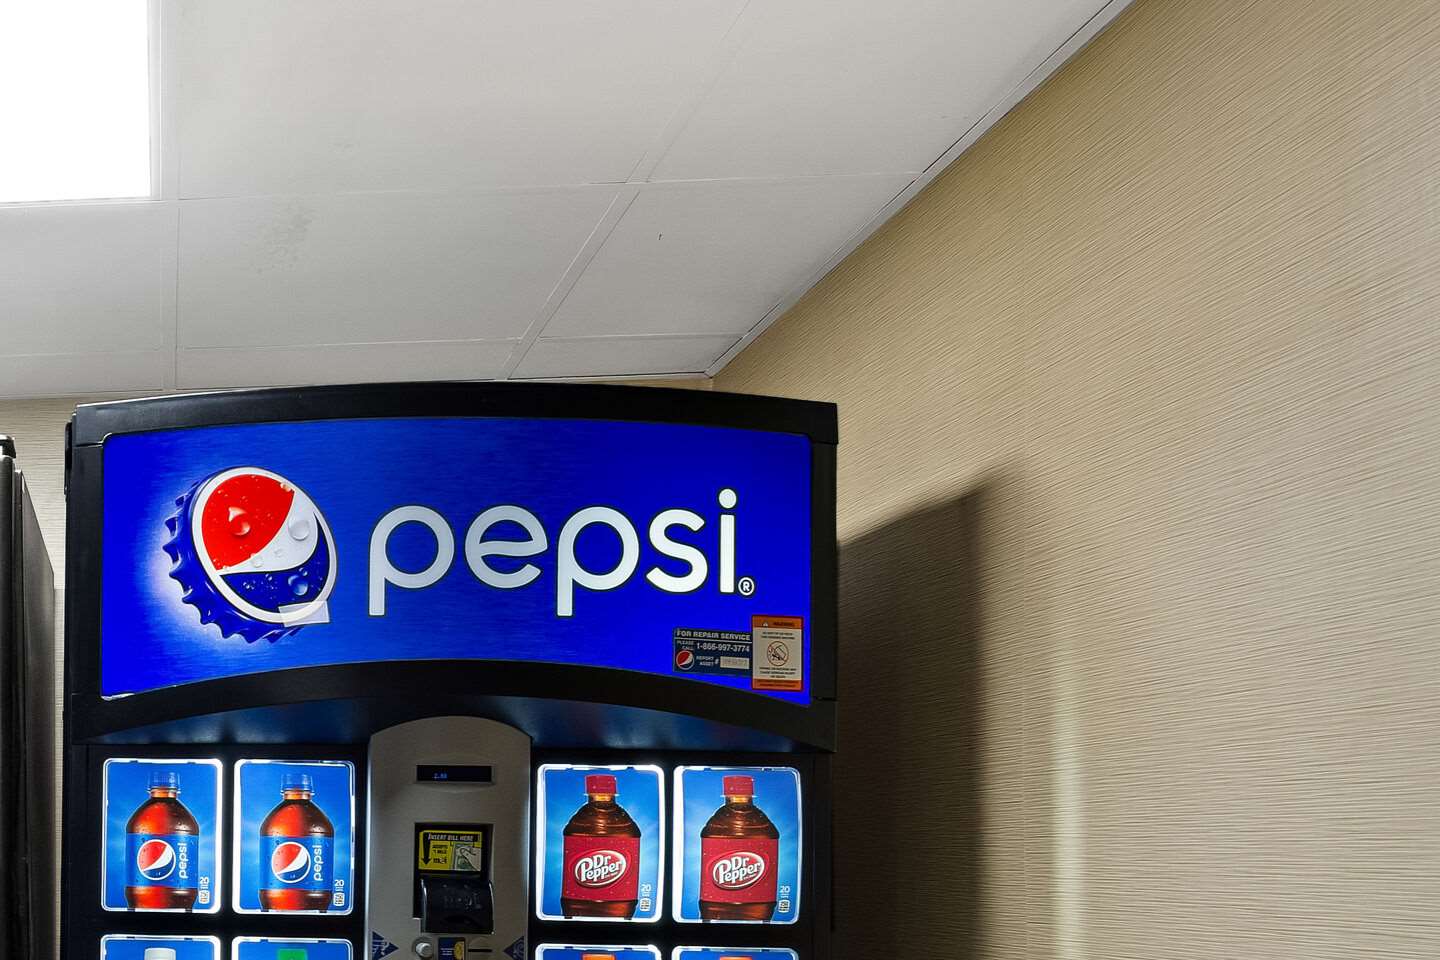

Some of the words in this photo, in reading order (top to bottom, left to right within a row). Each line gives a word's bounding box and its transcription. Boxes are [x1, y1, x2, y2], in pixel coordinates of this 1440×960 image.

[369, 487, 739, 617] pepsi
[676, 629, 691, 637] FOR
[693, 631, 719, 639] REPAIR
[720, 632, 750, 641] SERVICE
[178, 842, 187, 879] pepsi
[312, 844, 324, 881] pepsi
[579, 858, 622, 883] Pepper
[593, 854, 612, 869] Dr
[717, 860, 762, 884] Pepper
[731, 856, 750, 871] Dr
